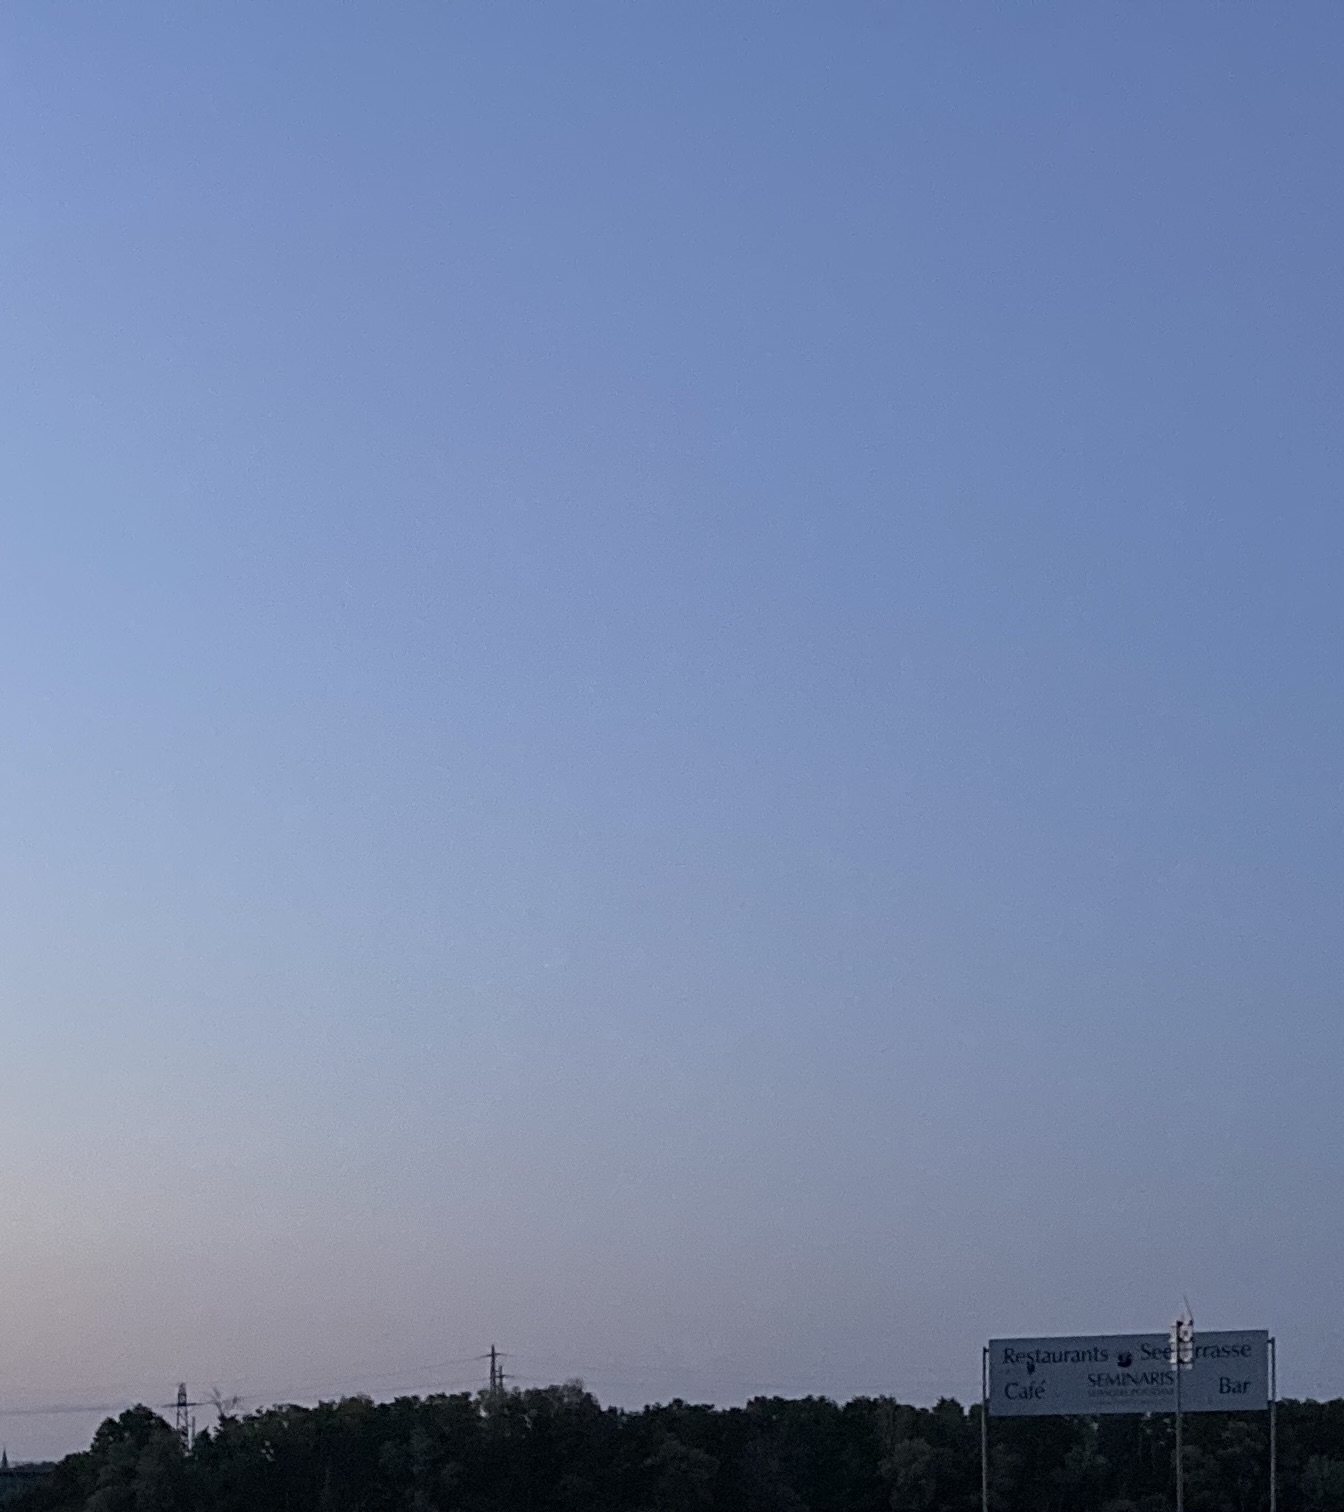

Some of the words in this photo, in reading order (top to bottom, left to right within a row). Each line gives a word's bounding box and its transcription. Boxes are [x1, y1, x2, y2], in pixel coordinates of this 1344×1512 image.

[1003, 1346, 1110, 1364] Restaurants
[1141, 1342, 1252, 1361] Seerrasse
[1087, 1371, 1175, 1387] SEMINARIS
[1219, 1376, 1252, 1395] Bar
[1004, 1379, 1046, 1401] Café
